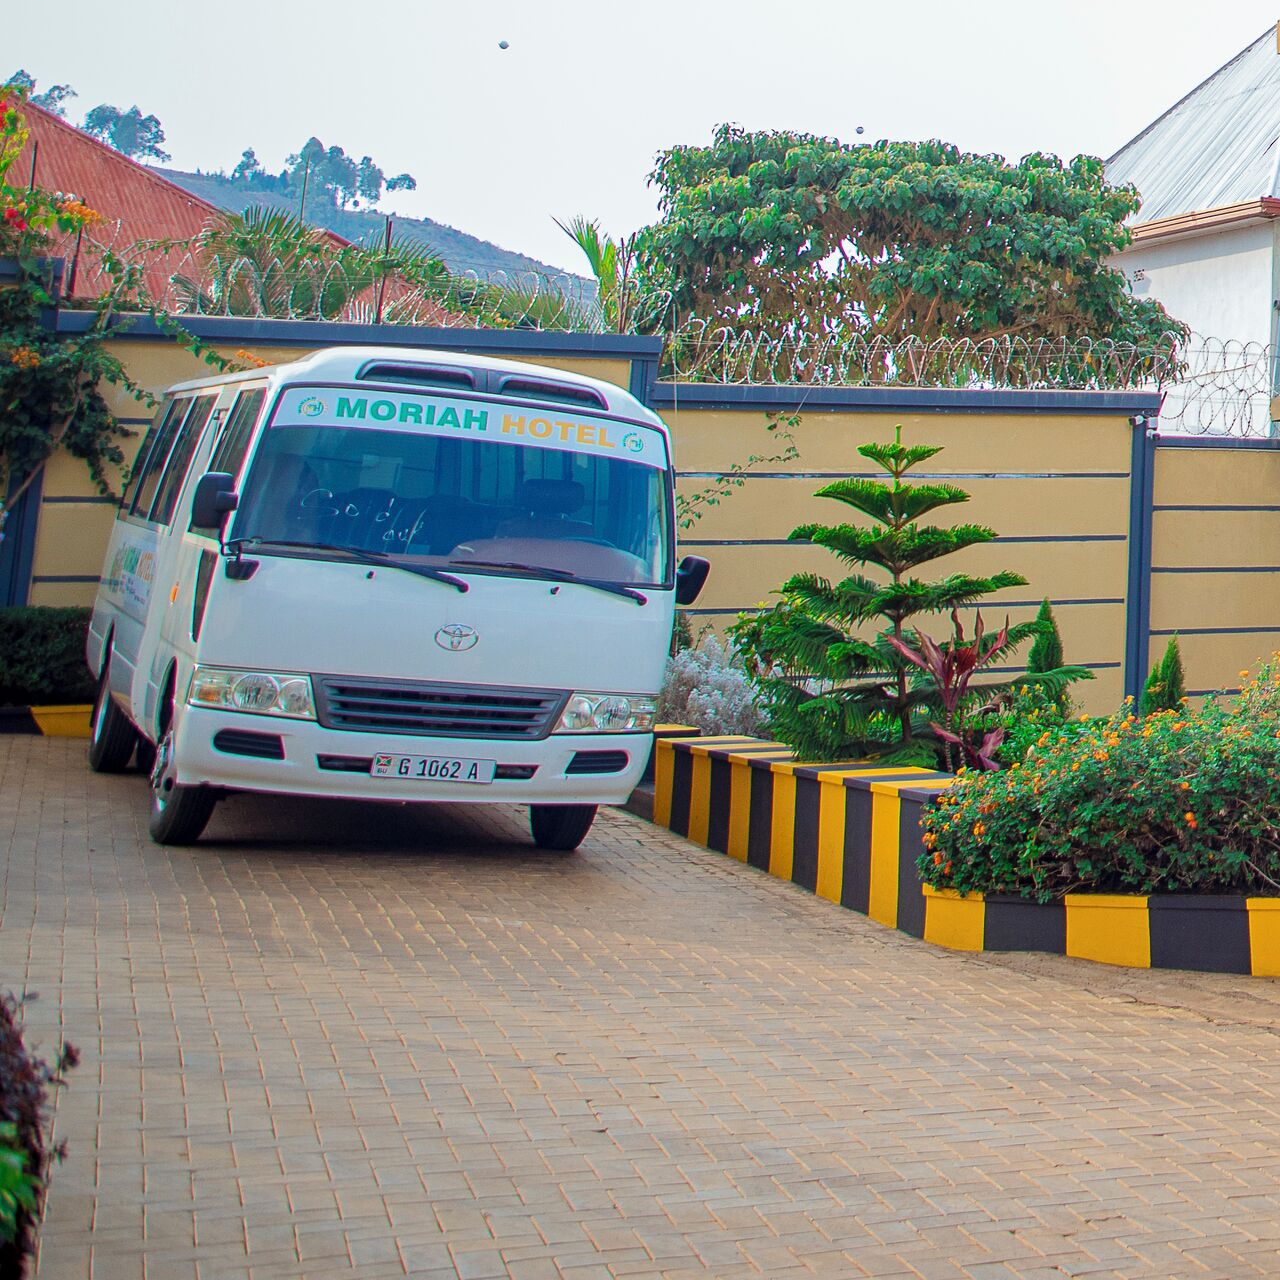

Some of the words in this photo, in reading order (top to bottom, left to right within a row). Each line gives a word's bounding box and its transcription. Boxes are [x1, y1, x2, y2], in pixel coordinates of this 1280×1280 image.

[336, 397, 489, 431] MORIAH
[502, 413, 615, 448] HOTEL
[398, 757, 412, 775] G
[416, 759, 462, 779] 1062
[467, 762, 479, 780] A
